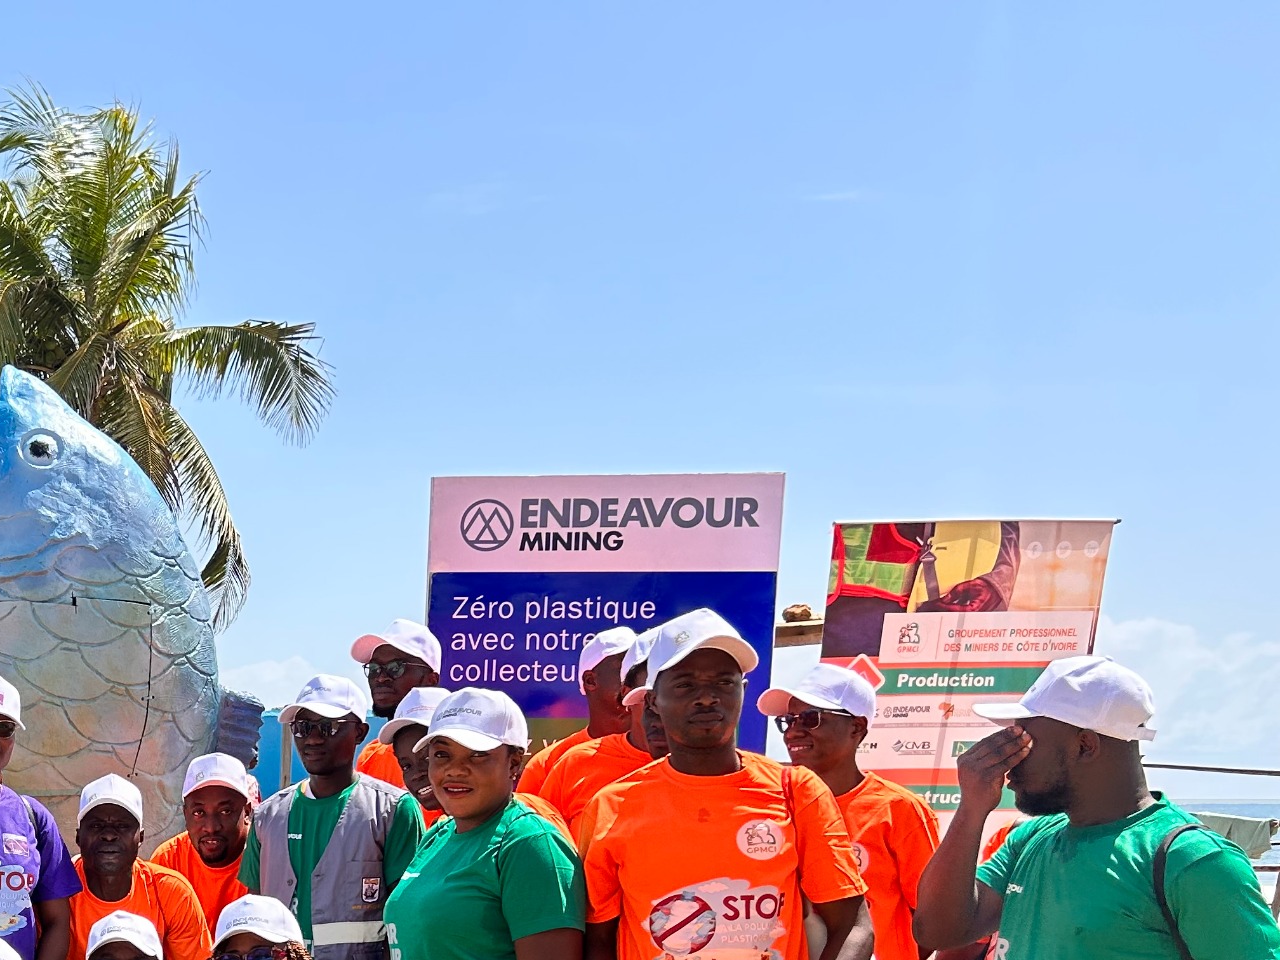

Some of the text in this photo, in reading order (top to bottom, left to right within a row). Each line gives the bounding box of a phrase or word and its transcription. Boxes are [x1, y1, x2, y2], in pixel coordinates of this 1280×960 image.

[520, 497, 759, 528] ENDEAVOUR
[519, 531, 624, 551] MINING
[452, 595, 656, 623] Zéro plastique
[451, 632, 514, 650] avec
[948, 628, 1077, 638] GROUPEMENT PROFESSIONNEL
[944, 640, 1077, 652] DES MINIERS DE CÔTE D'IVOIRE
[449, 659, 576, 682] collecteu
[897, 673, 995, 688] Production
[917, 791, 961, 804] truc
[722, 892, 785, 921] STOP
